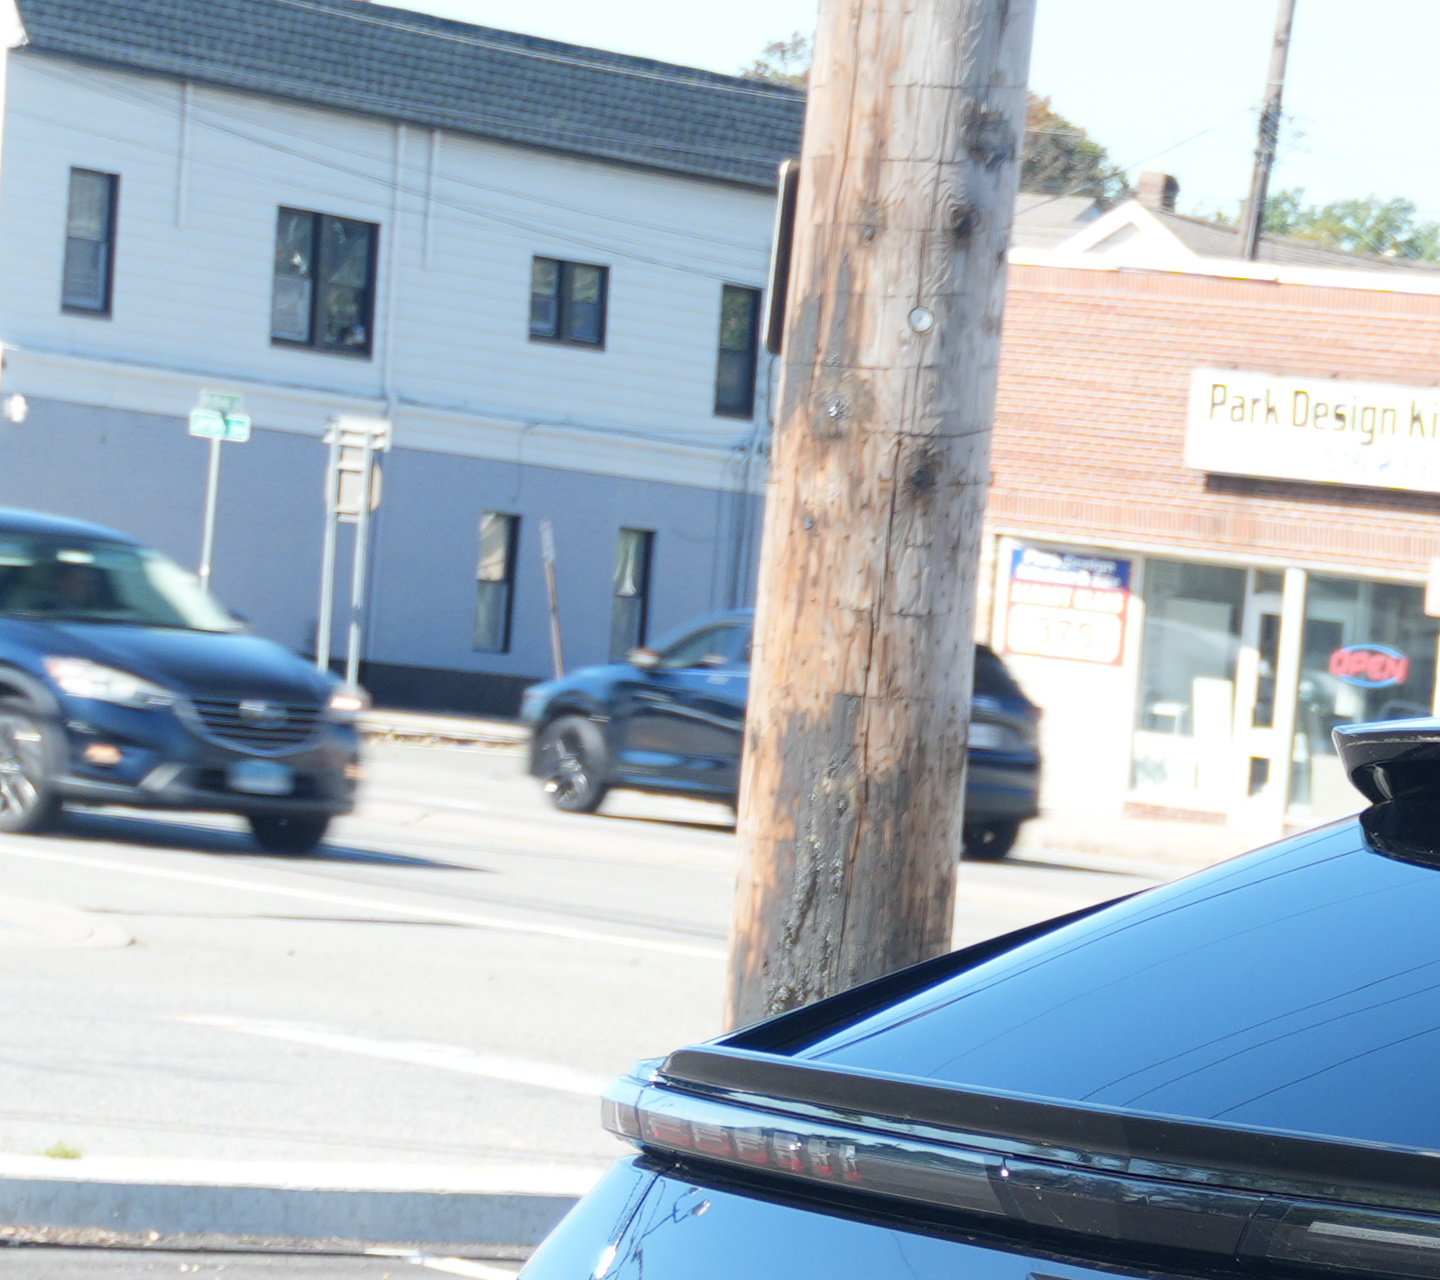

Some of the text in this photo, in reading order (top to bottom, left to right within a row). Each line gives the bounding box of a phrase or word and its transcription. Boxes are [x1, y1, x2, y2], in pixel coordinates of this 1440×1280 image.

[1208, 382, 1280, 426] Park
[1291, 389, 1397, 447] Design
[1329, 648, 1410, 684] OPEN
